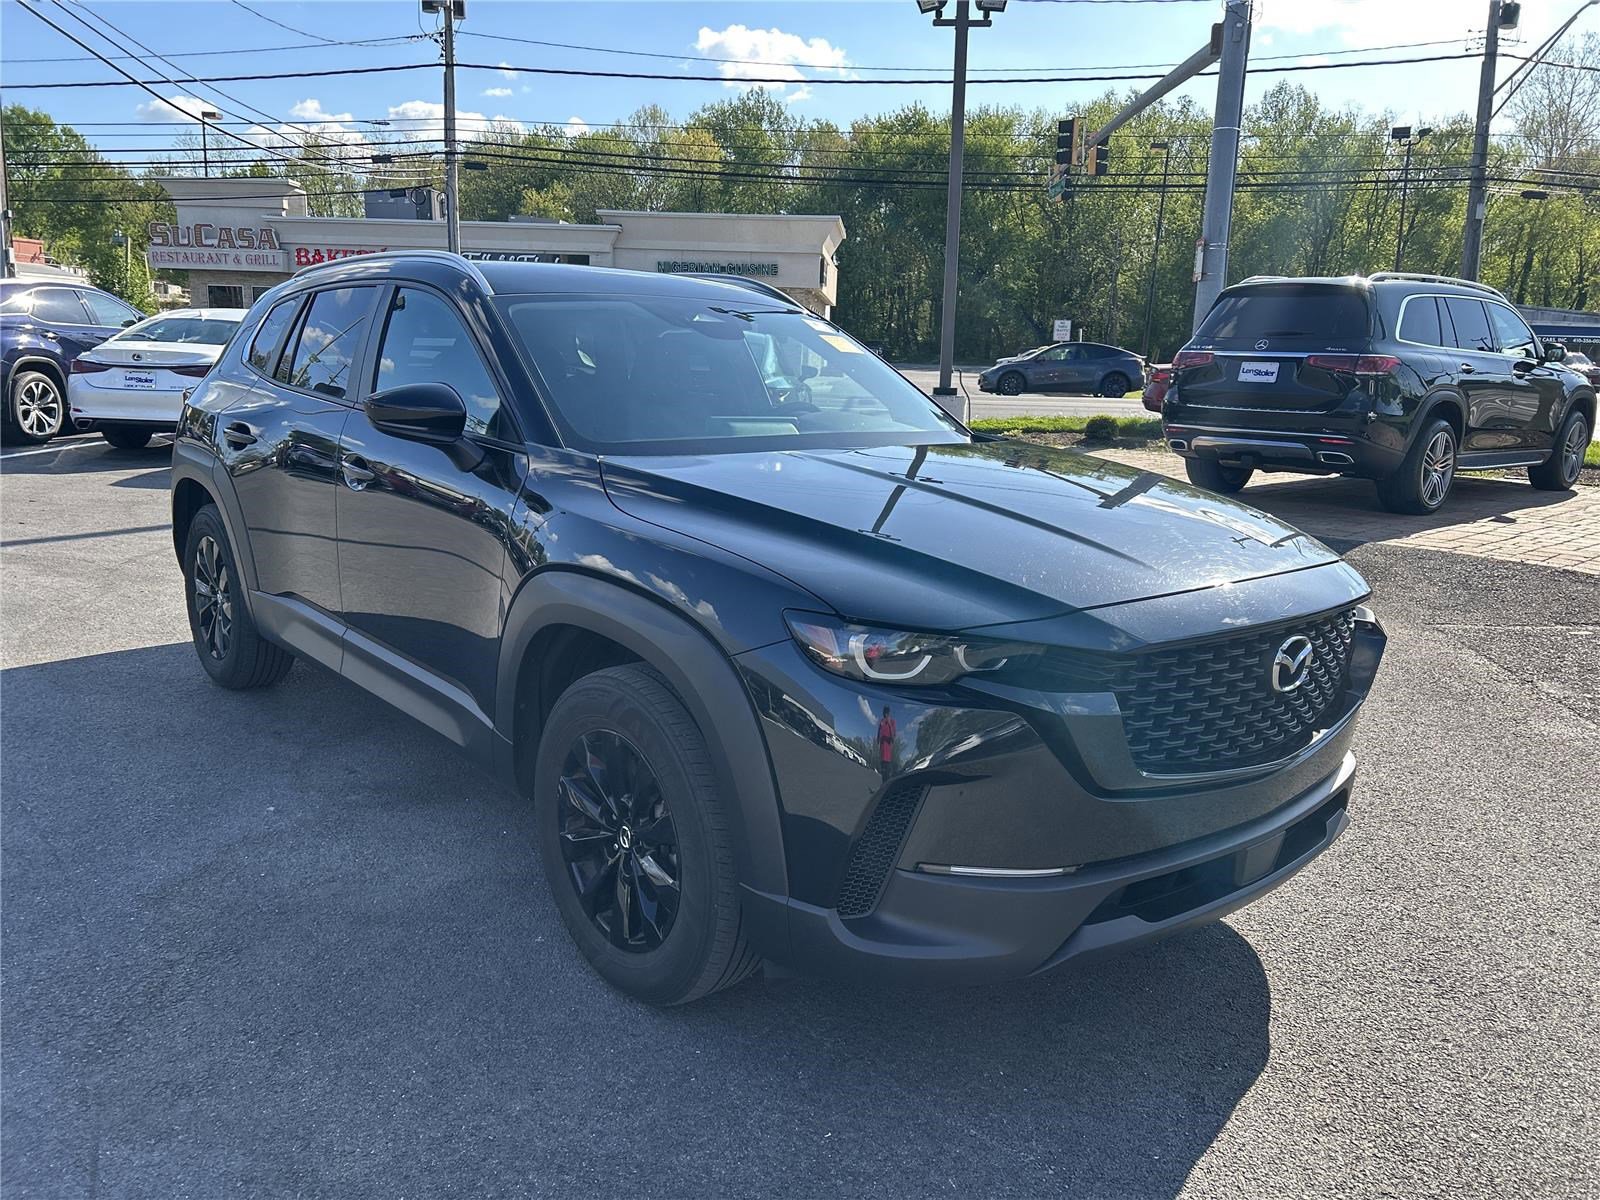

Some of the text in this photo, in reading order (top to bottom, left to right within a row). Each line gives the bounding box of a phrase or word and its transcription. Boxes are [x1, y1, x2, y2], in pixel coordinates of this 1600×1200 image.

[151, 251, 280, 266] RESTAURANT & GRILL
[295, 247, 388, 266] BAKE
[657, 261, 779, 276] NIGERIAN CUISINE
